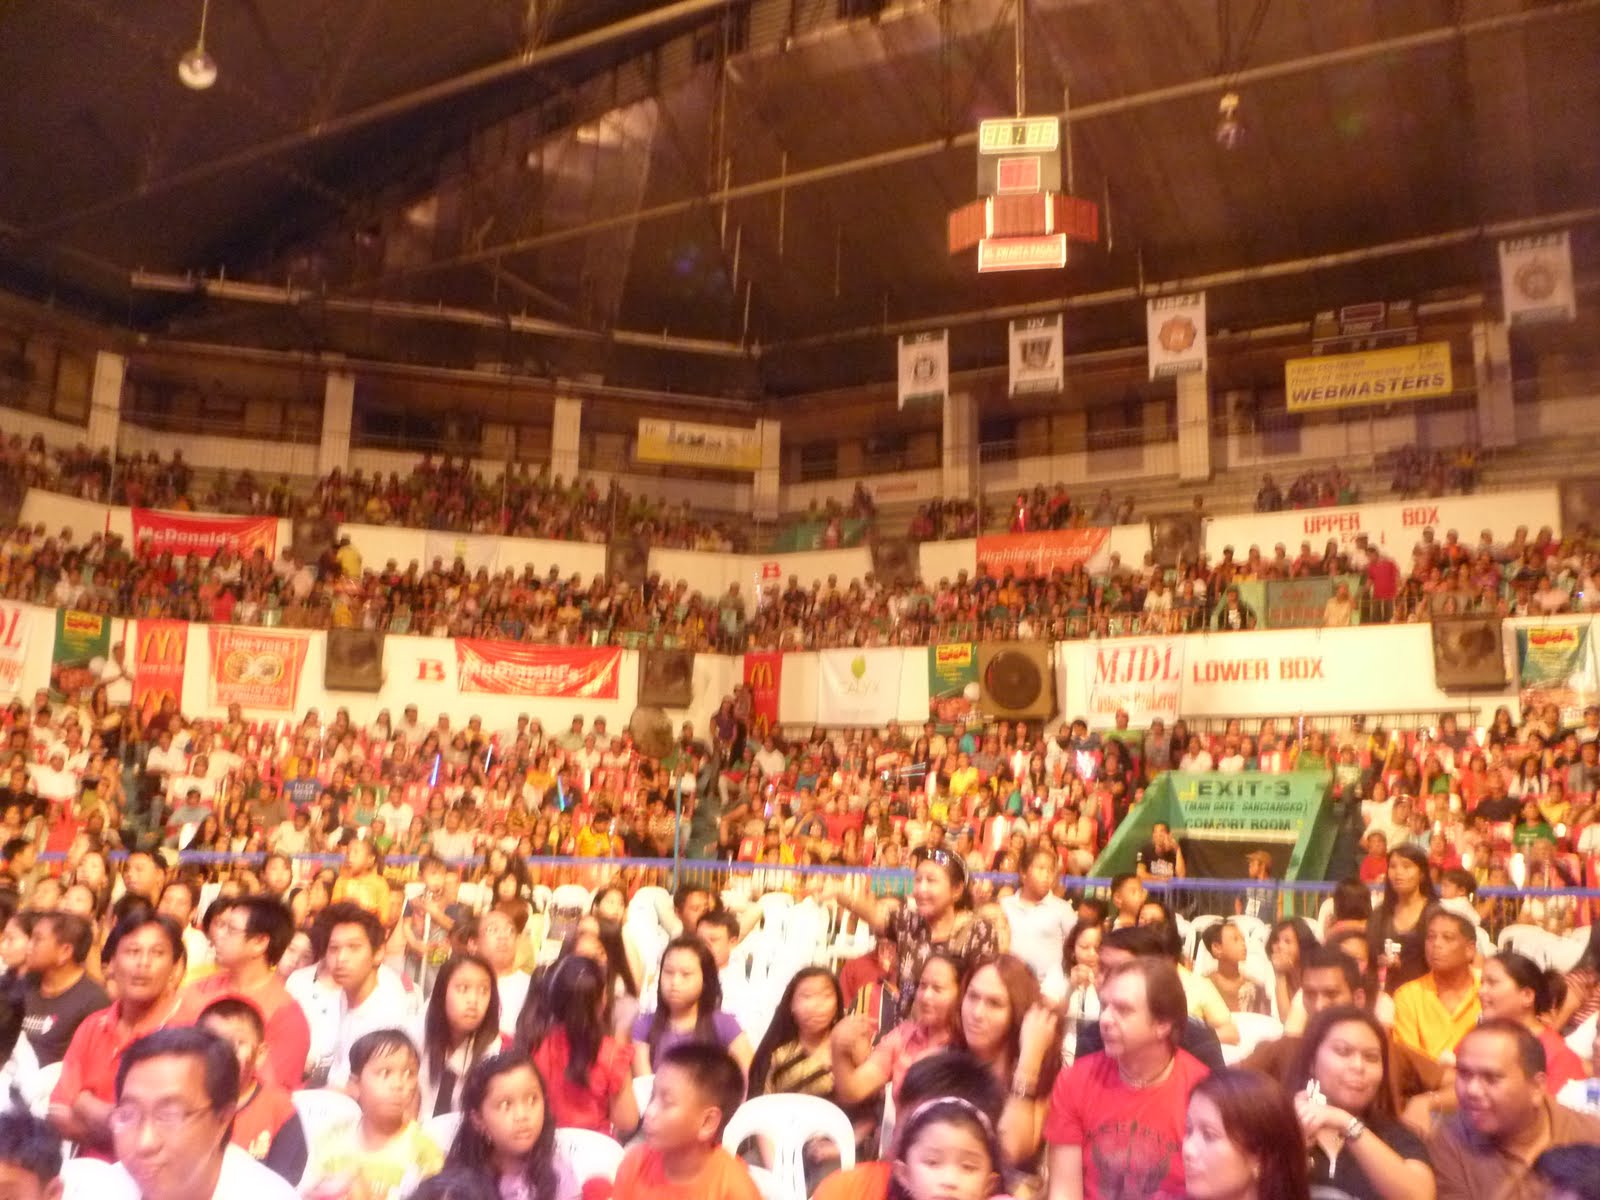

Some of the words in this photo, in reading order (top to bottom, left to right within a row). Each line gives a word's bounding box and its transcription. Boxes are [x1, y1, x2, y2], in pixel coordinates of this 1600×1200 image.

[1292, 372, 1446, 403] WEBMASTERS
[1304, 511, 1361, 534] UPPER
[1402, 505, 1440, 526] BOX
[138, 526, 240, 546] McDonald's
[1095, 645, 1180, 684] MJDL
[1193, 659, 1269, 683] LOWER
[1280, 656, 1325, 680] BOX
[1199, 779, 1291, 798] EXIT-3
[1184, 818, 1245, 830] COMFORT
[1250, 818, 1291, 831] ROOM
